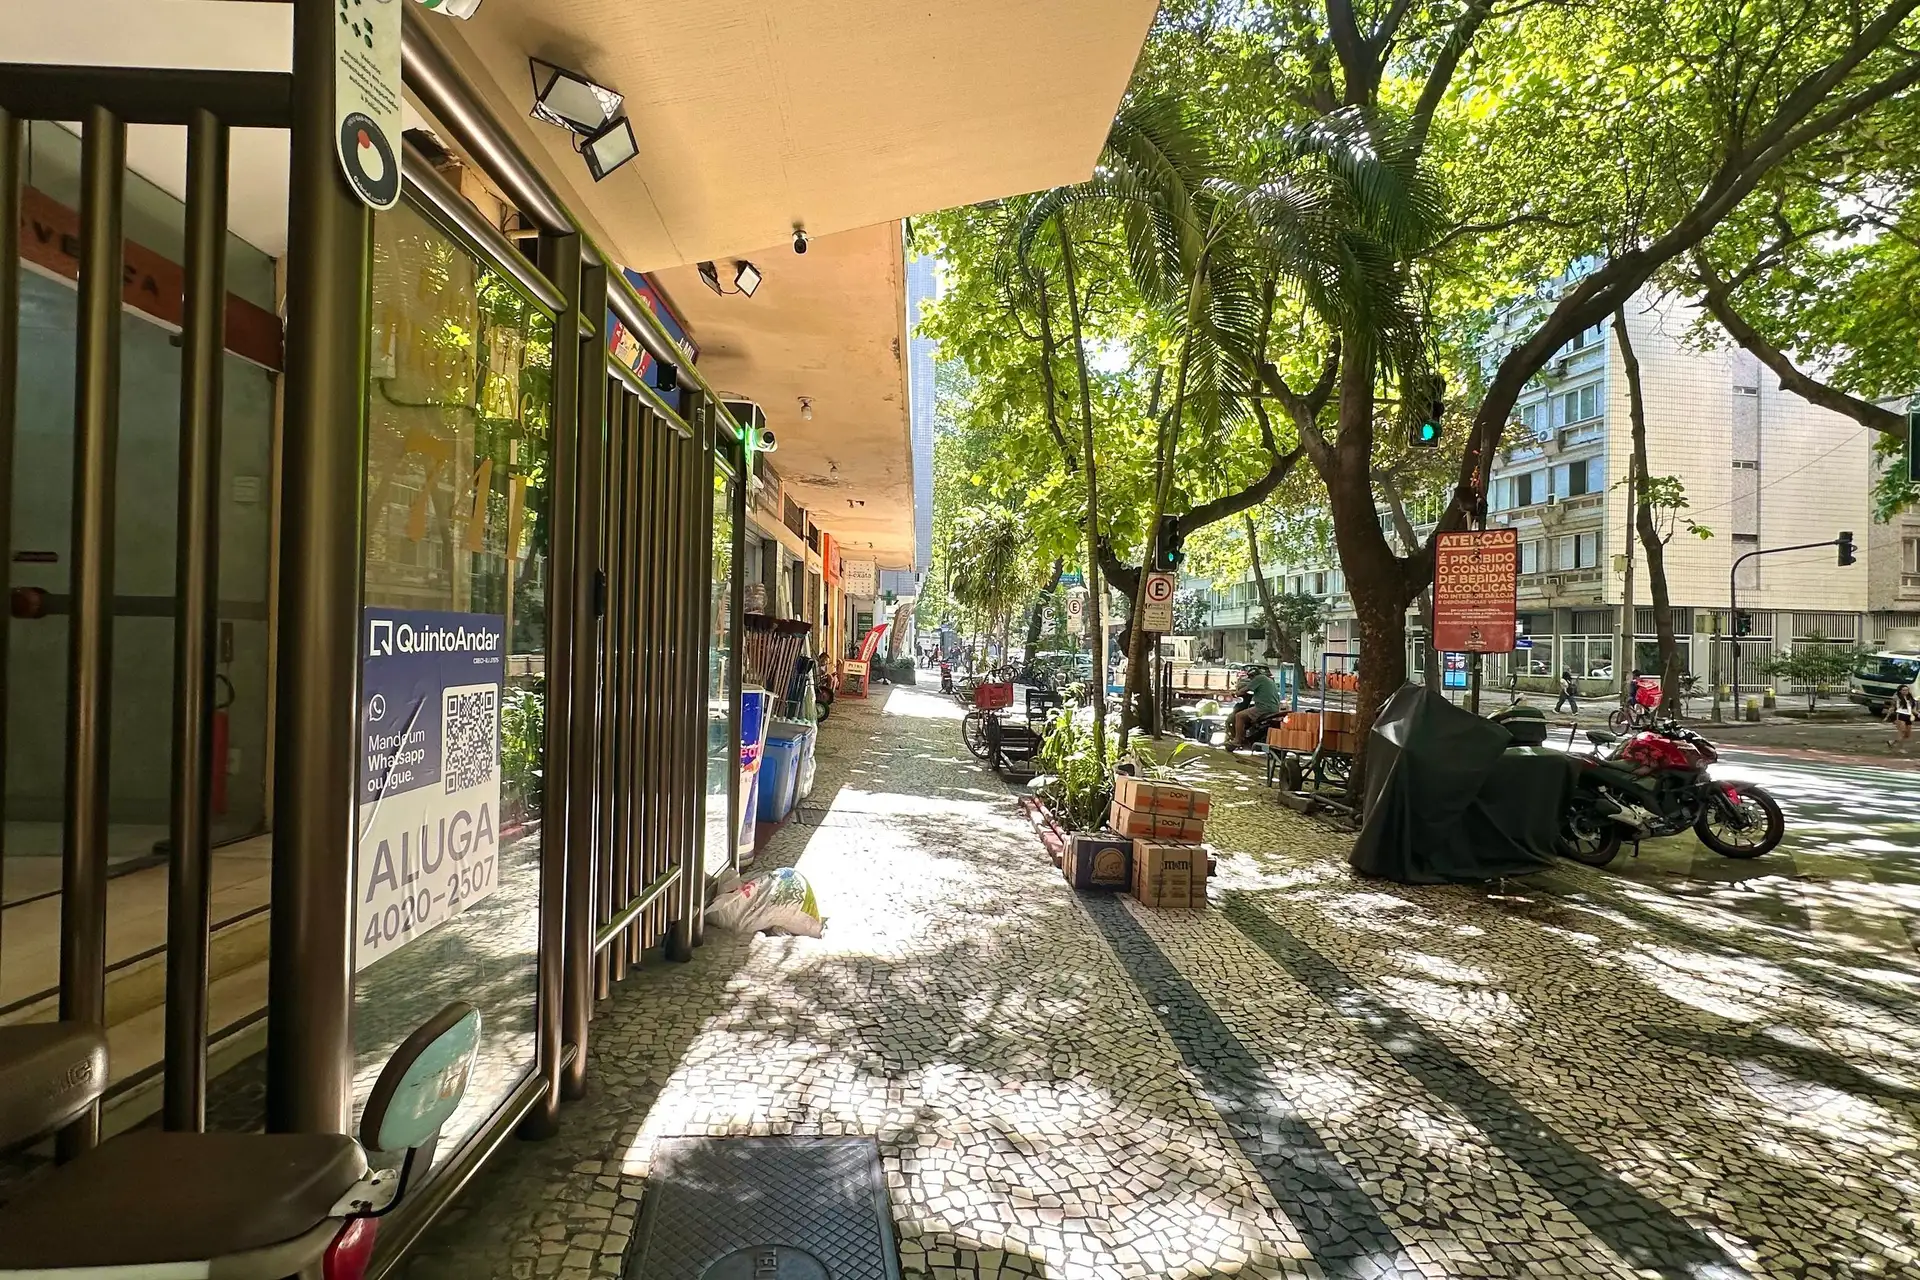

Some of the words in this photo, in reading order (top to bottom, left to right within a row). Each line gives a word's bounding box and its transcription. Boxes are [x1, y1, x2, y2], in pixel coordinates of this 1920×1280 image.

[1439, 530, 1515, 548] ATENÇÃO
[1439, 552, 1448, 565] É
[1450, 552, 1515, 565] PROIBIDO
[1438, 565, 1449, 574] O
[1451, 563, 1515, 574] CONSUMO
[1438, 574, 1457, 584] DE
[1459, 572, 1515, 584] BEBIDAS
[1155, 582, 1165, 596] E
[1438, 581, 1515, 593] ALCOÓLICAS
[396, 624, 500, 655] QuintoAndar
[368, 731, 407, 752] Mande
[408, 729, 425, 743] um
[367, 747, 425, 772] Whatsapp
[367, 777, 384, 792] ou
[1169, 791, 1189, 799] DOM
[1161, 819, 1181, 827] DOM
[365, 802, 494, 904] ALUGA
[363, 855, 495, 949] 4020-2507
